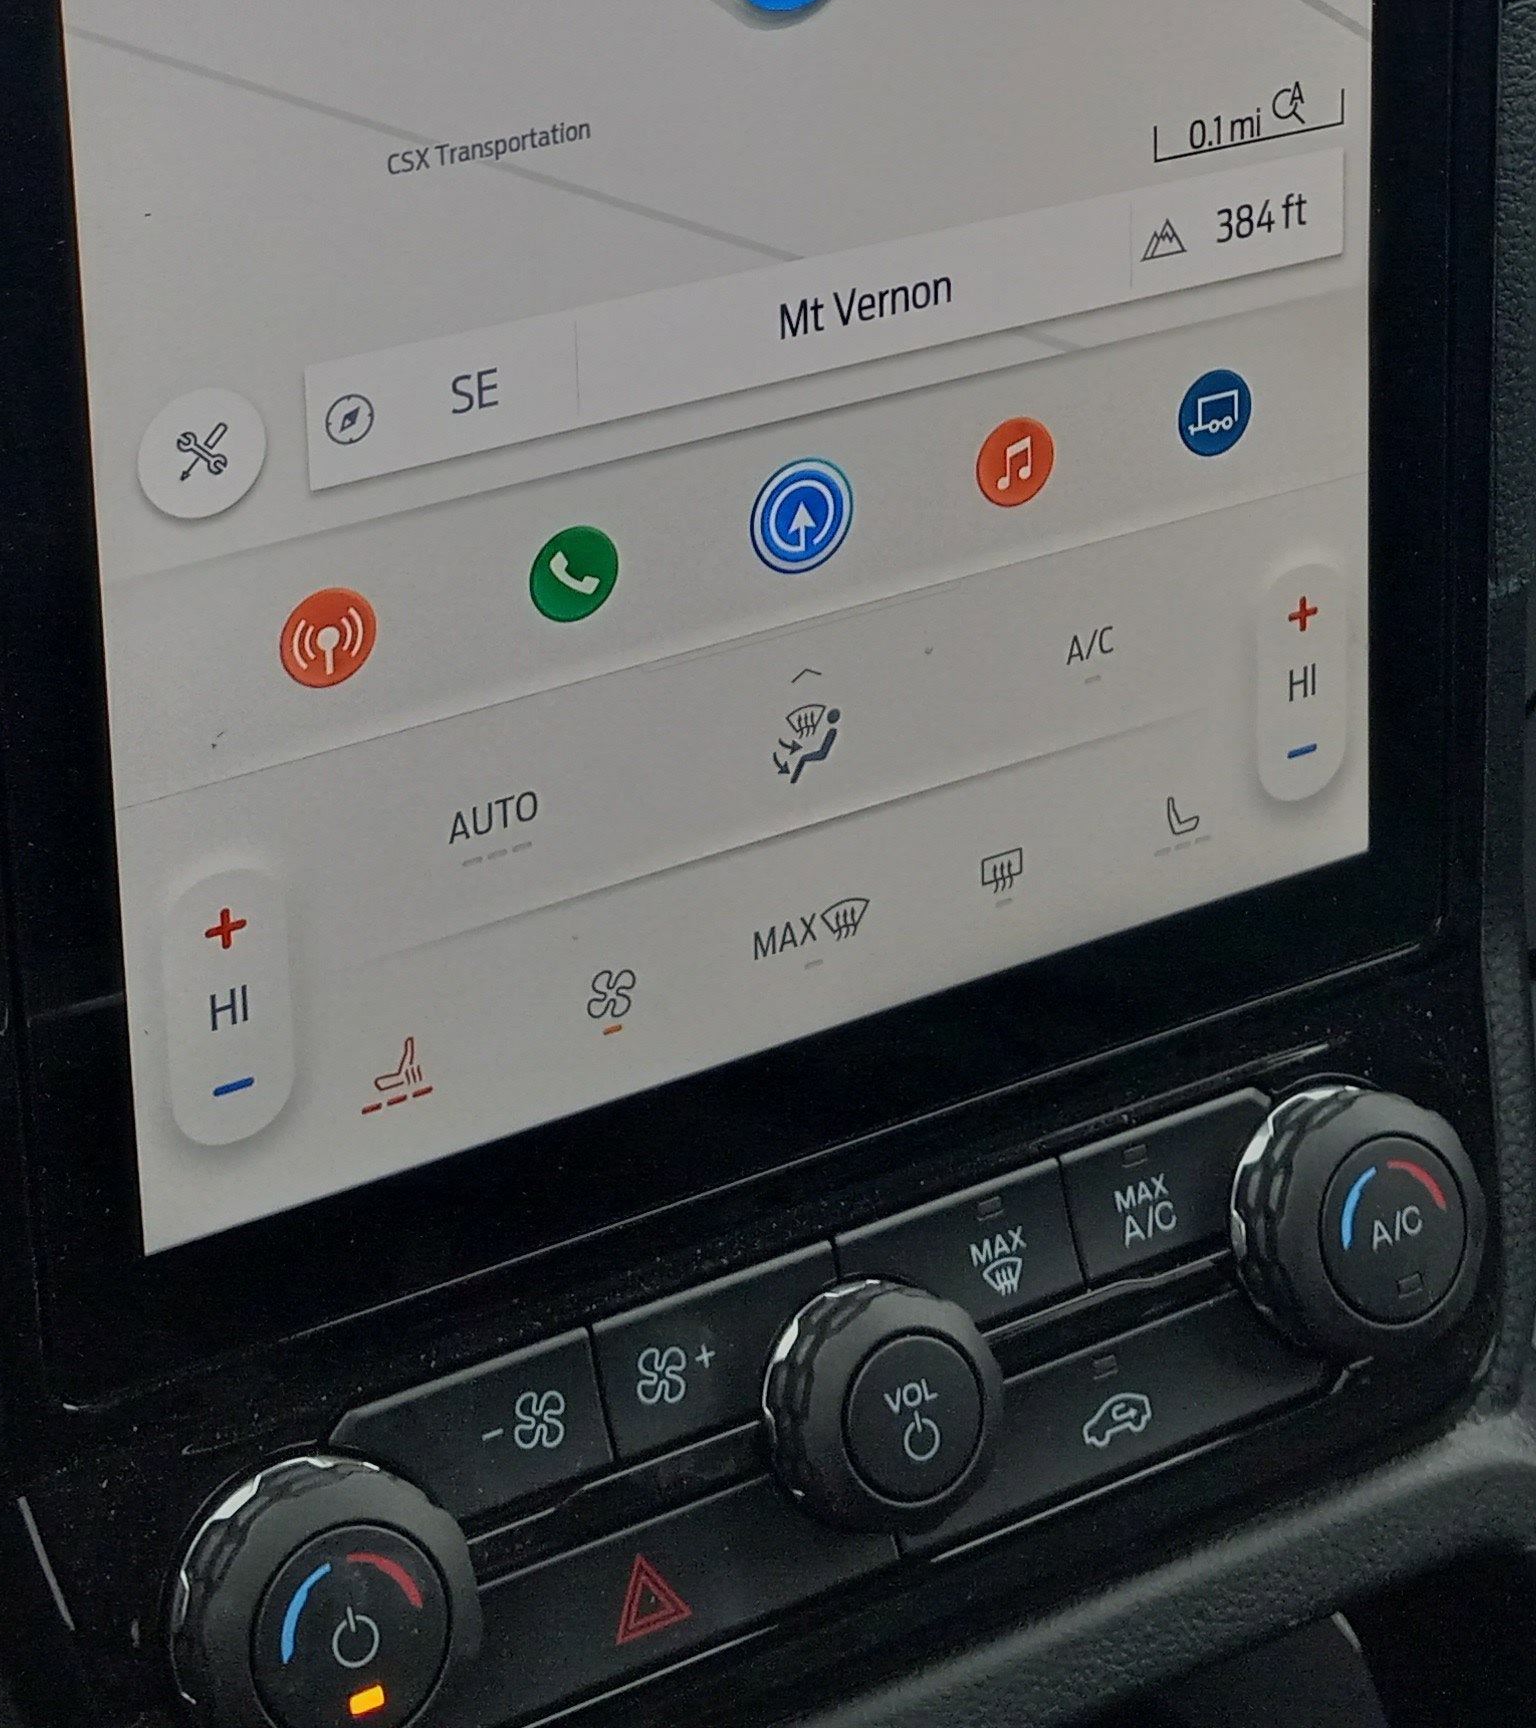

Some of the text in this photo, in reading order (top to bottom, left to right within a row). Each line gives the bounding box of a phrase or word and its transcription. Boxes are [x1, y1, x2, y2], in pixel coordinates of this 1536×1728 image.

[387, 122, 592, 175] CSX Transportation
[1189, 107, 1261, 149] 0.1 mi
[1216, 193, 1307, 244] 384 ft
[779, 276, 953, 340] Mt Vernon
[451, 368, 499, 414] SE
[1066, 625, 1115, 668] A/C
[1287, 663, 1317, 703] HI
[449, 790, 540, 847] AUTO
[752, 913, 818, 961] MAX
[209, 985, 249, 1033] HI
[1114, 1174, 1170, 1213] MAX
[969, 1226, 1028, 1267] MAX
[1124, 1200, 1178, 1247] A/C
[1371, 1206, 1424, 1251] A/C
[884, 1379, 938, 1415] VOL
